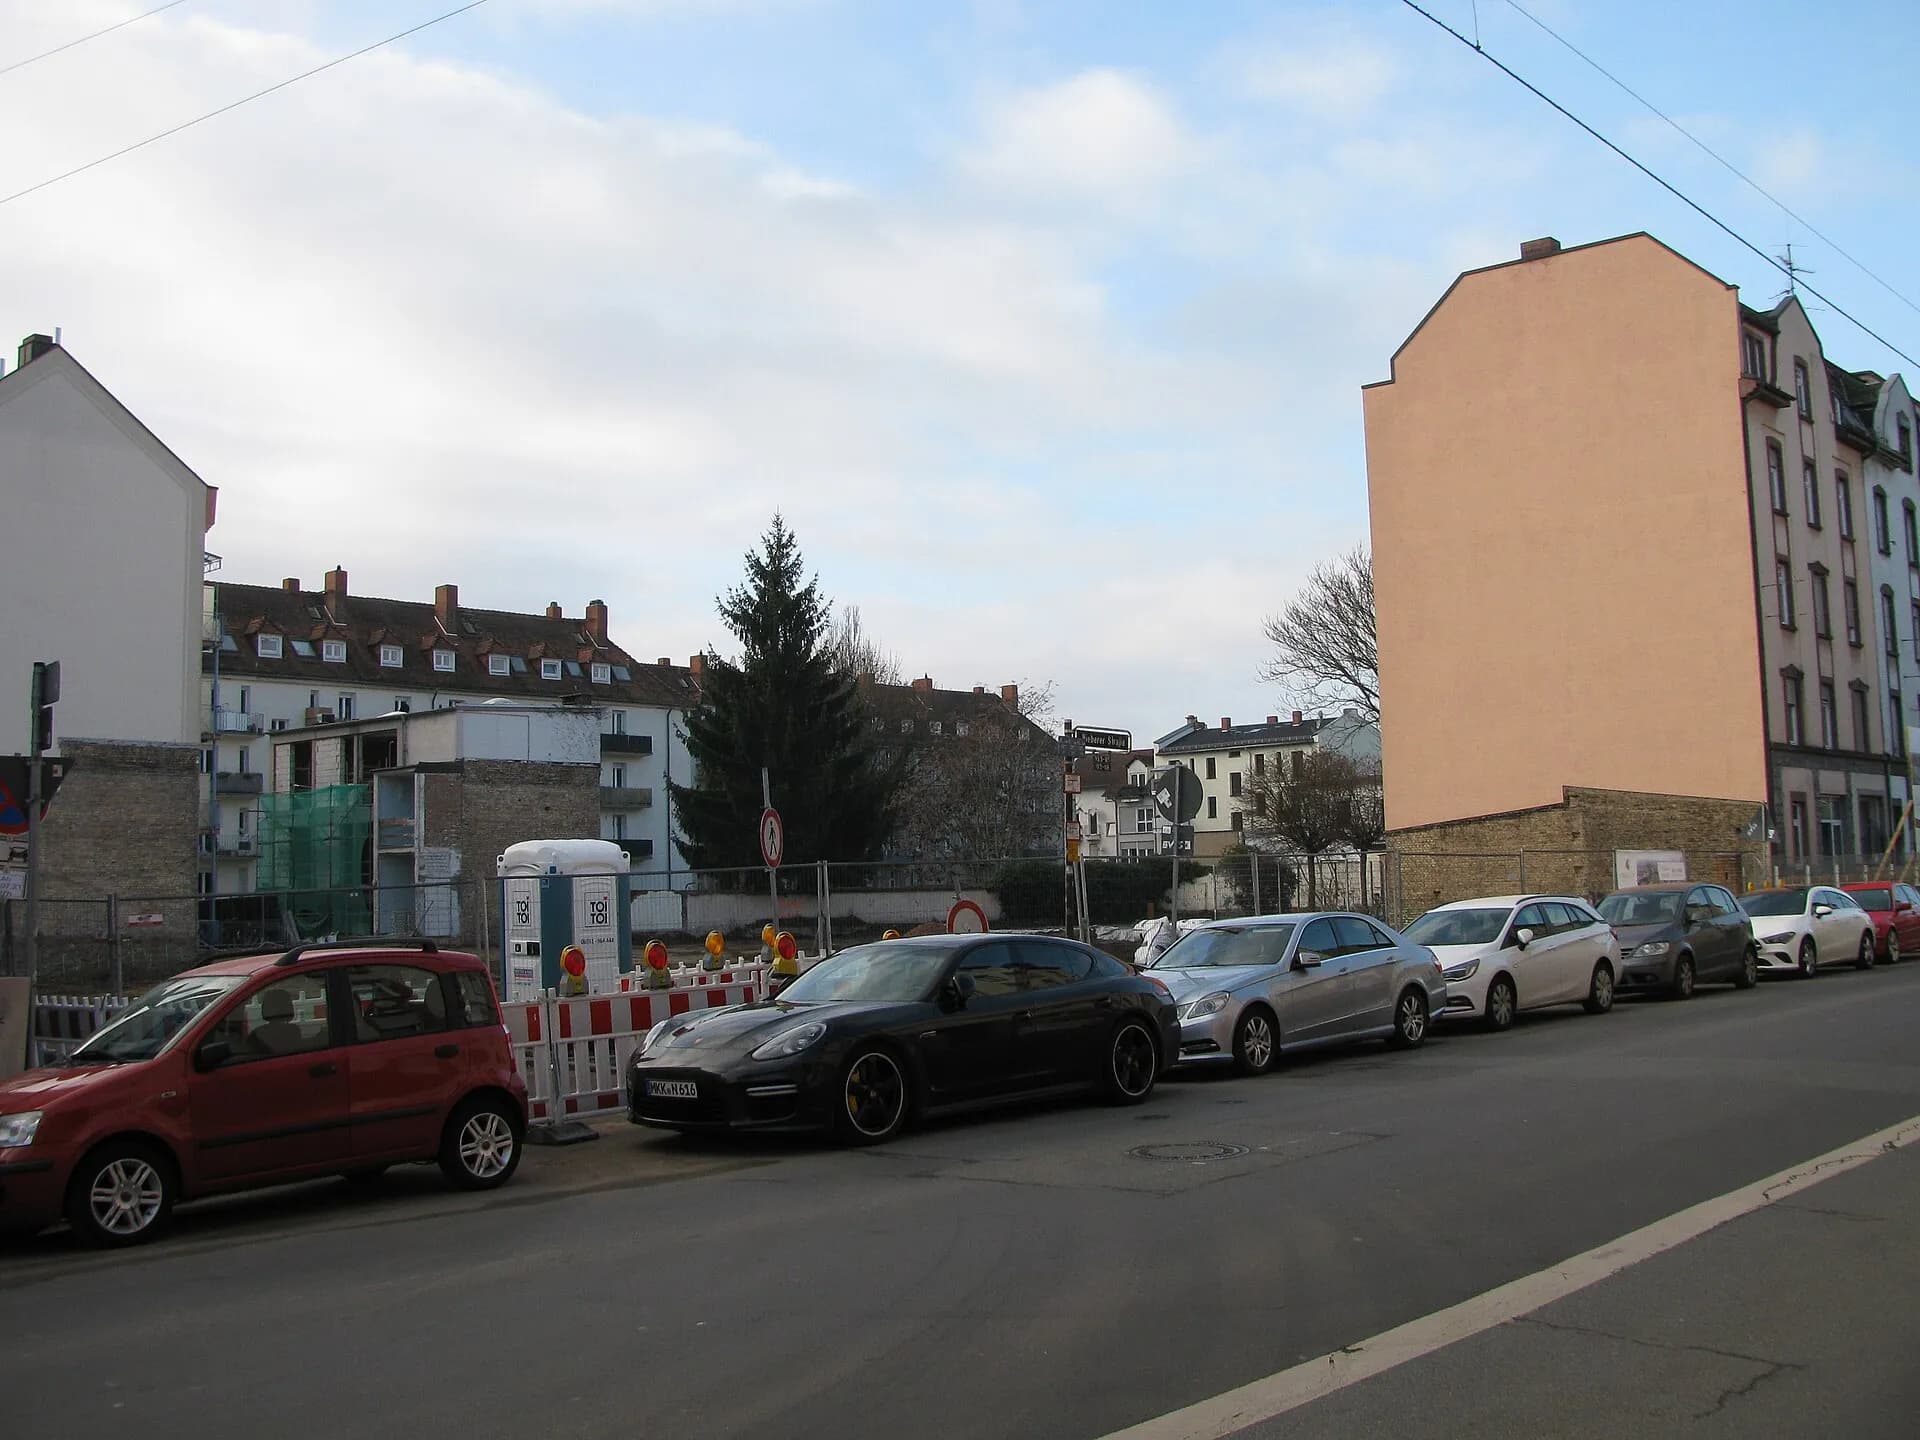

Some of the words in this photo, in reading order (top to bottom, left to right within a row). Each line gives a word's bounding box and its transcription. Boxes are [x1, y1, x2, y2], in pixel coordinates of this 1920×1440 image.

[516, 900, 529, 912] TOI
[590, 901, 608, 913] TOI
[517, 912, 530, 924] TOI
[590, 912, 608, 924] TOI
